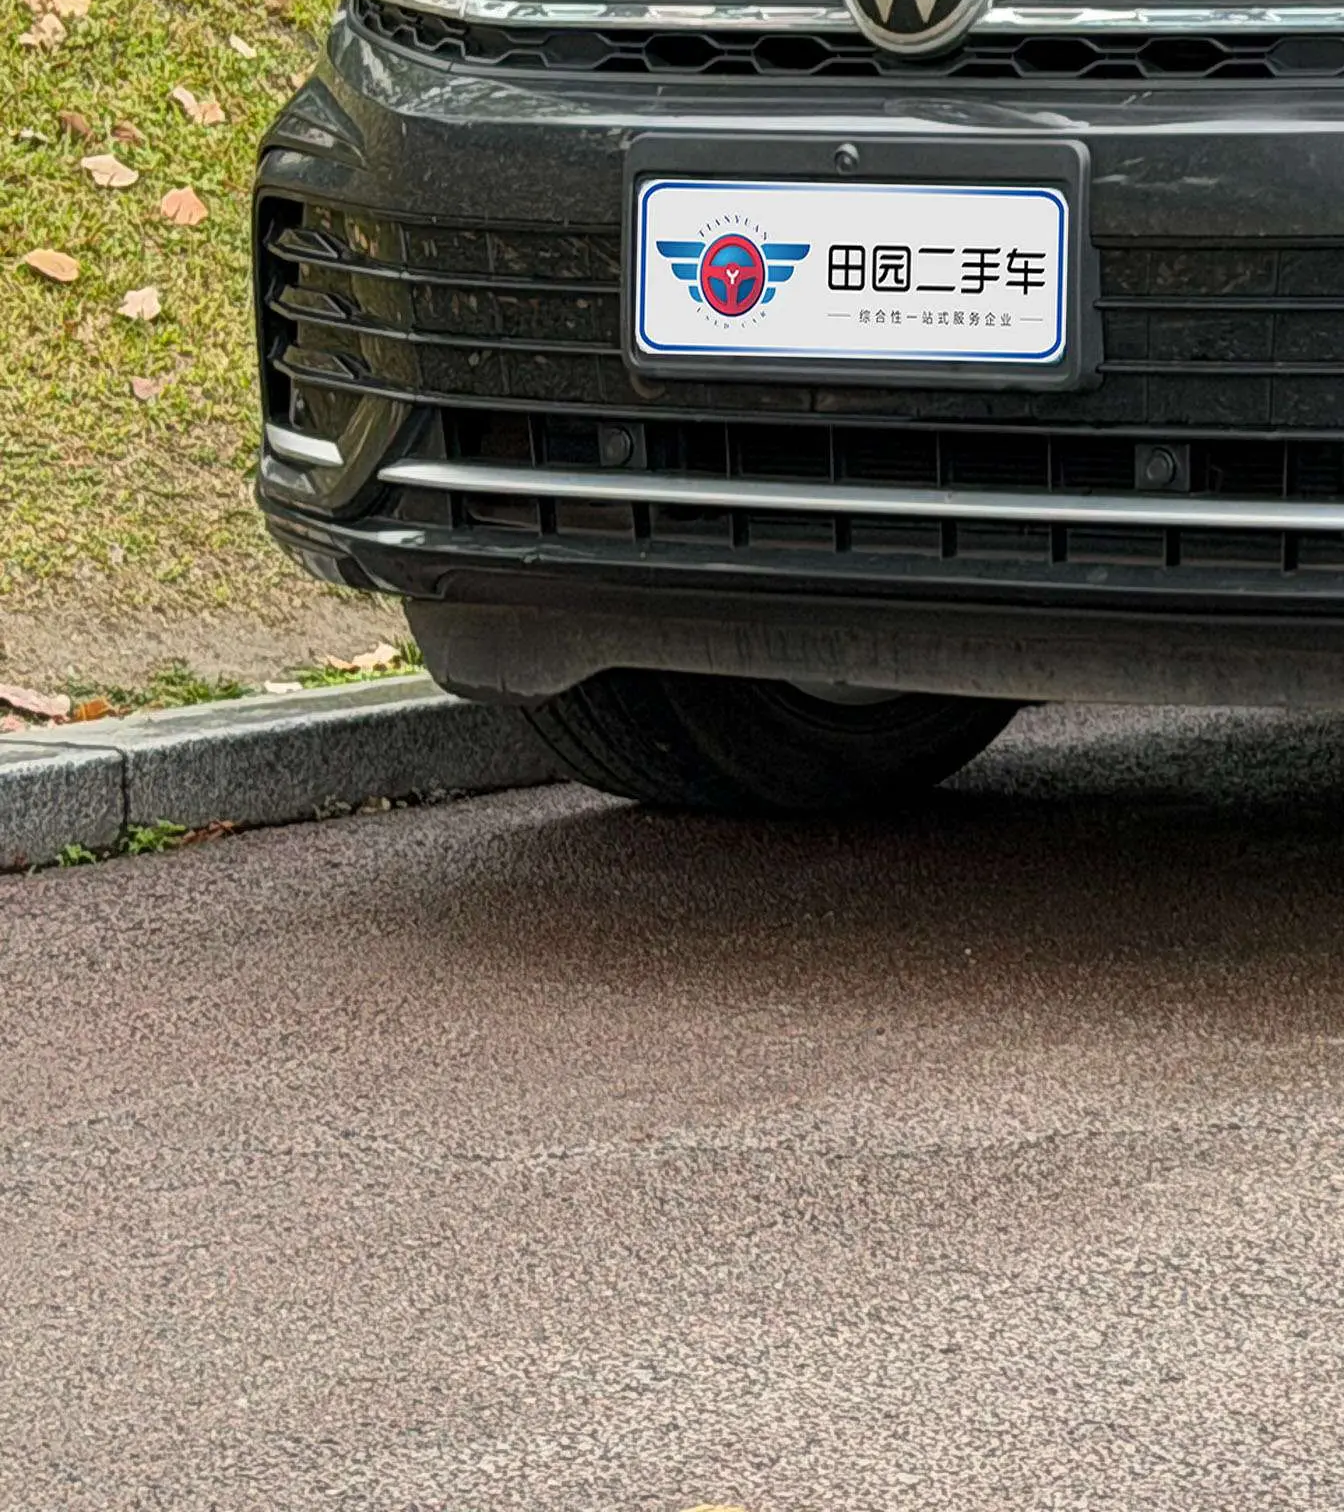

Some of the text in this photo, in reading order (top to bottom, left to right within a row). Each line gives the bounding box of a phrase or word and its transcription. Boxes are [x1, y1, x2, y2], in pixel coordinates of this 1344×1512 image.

[828, 244, 1047, 296] 田园二手车
[858, 309, 1012, 327] 综合性一站式服务企业
